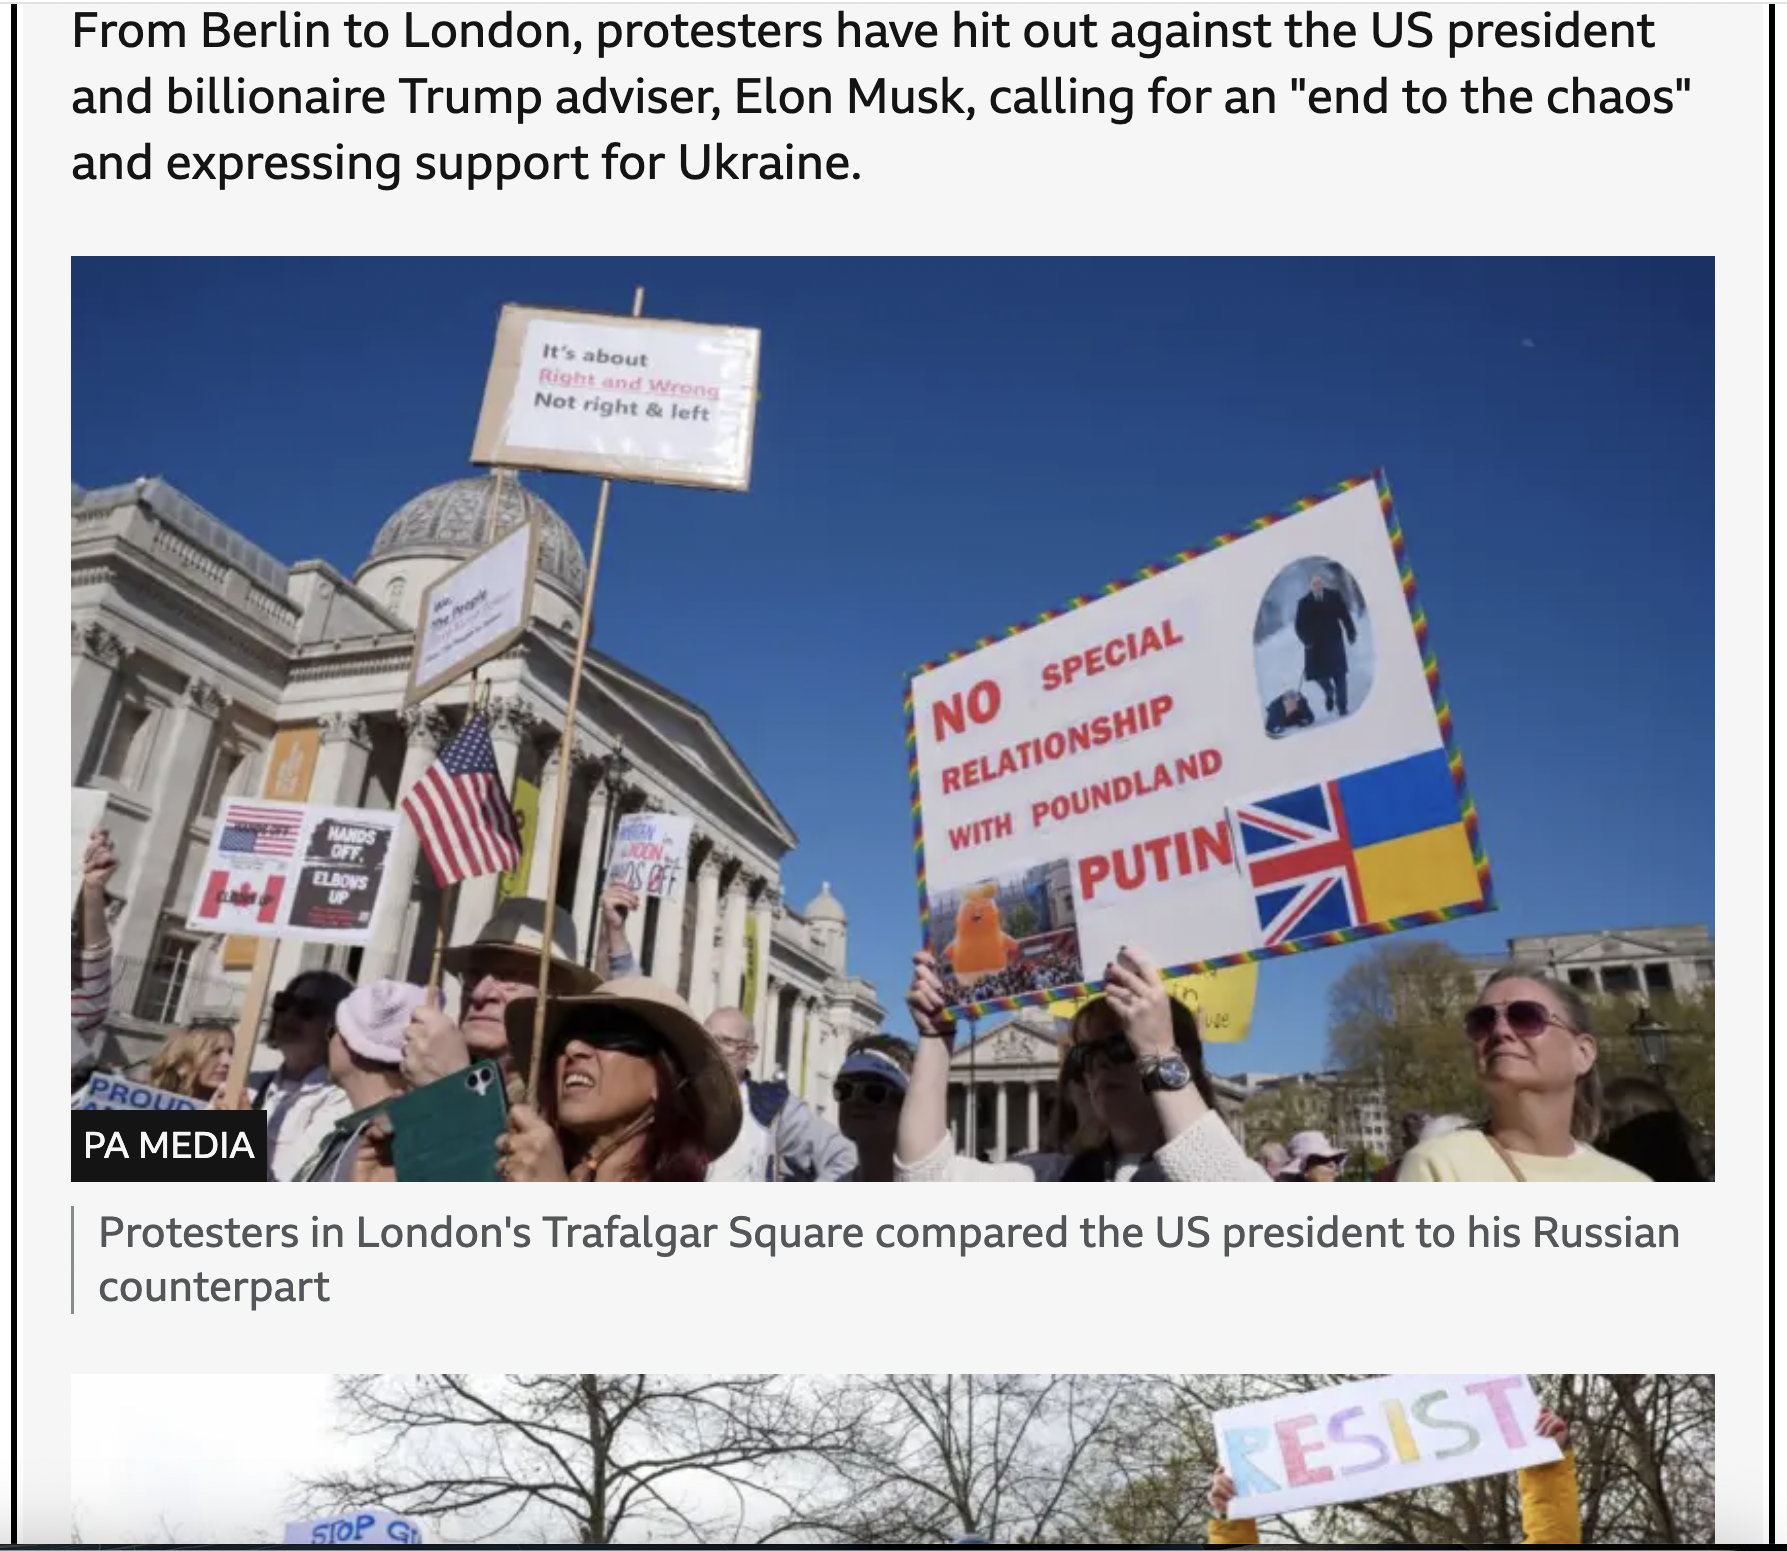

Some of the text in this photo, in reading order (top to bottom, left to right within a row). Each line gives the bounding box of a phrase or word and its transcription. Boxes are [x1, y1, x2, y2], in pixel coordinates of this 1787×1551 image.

[582, 348, 649, 368] about
[539, 368, 721, 402] Right and Wrong
[534, 391, 711, 422] Not right & left
[932, 619, 1184, 743] NO SPECIAL
[941, 694, 1174, 795] RELATIONSHIP
[948, 748, 1223, 851] WITH POUNDLAND
[327, 824, 378, 846] HANDS
[1077, 820, 1233, 901] PUTIN
[312, 869, 370, 891] ELBOWS
[328, 888, 351, 906] UP
[88, 1076, 197, 1110] PROUD
[1221, 1375, 1530, 1499] RESIST
[311, 1514, 376, 1544] STOP
